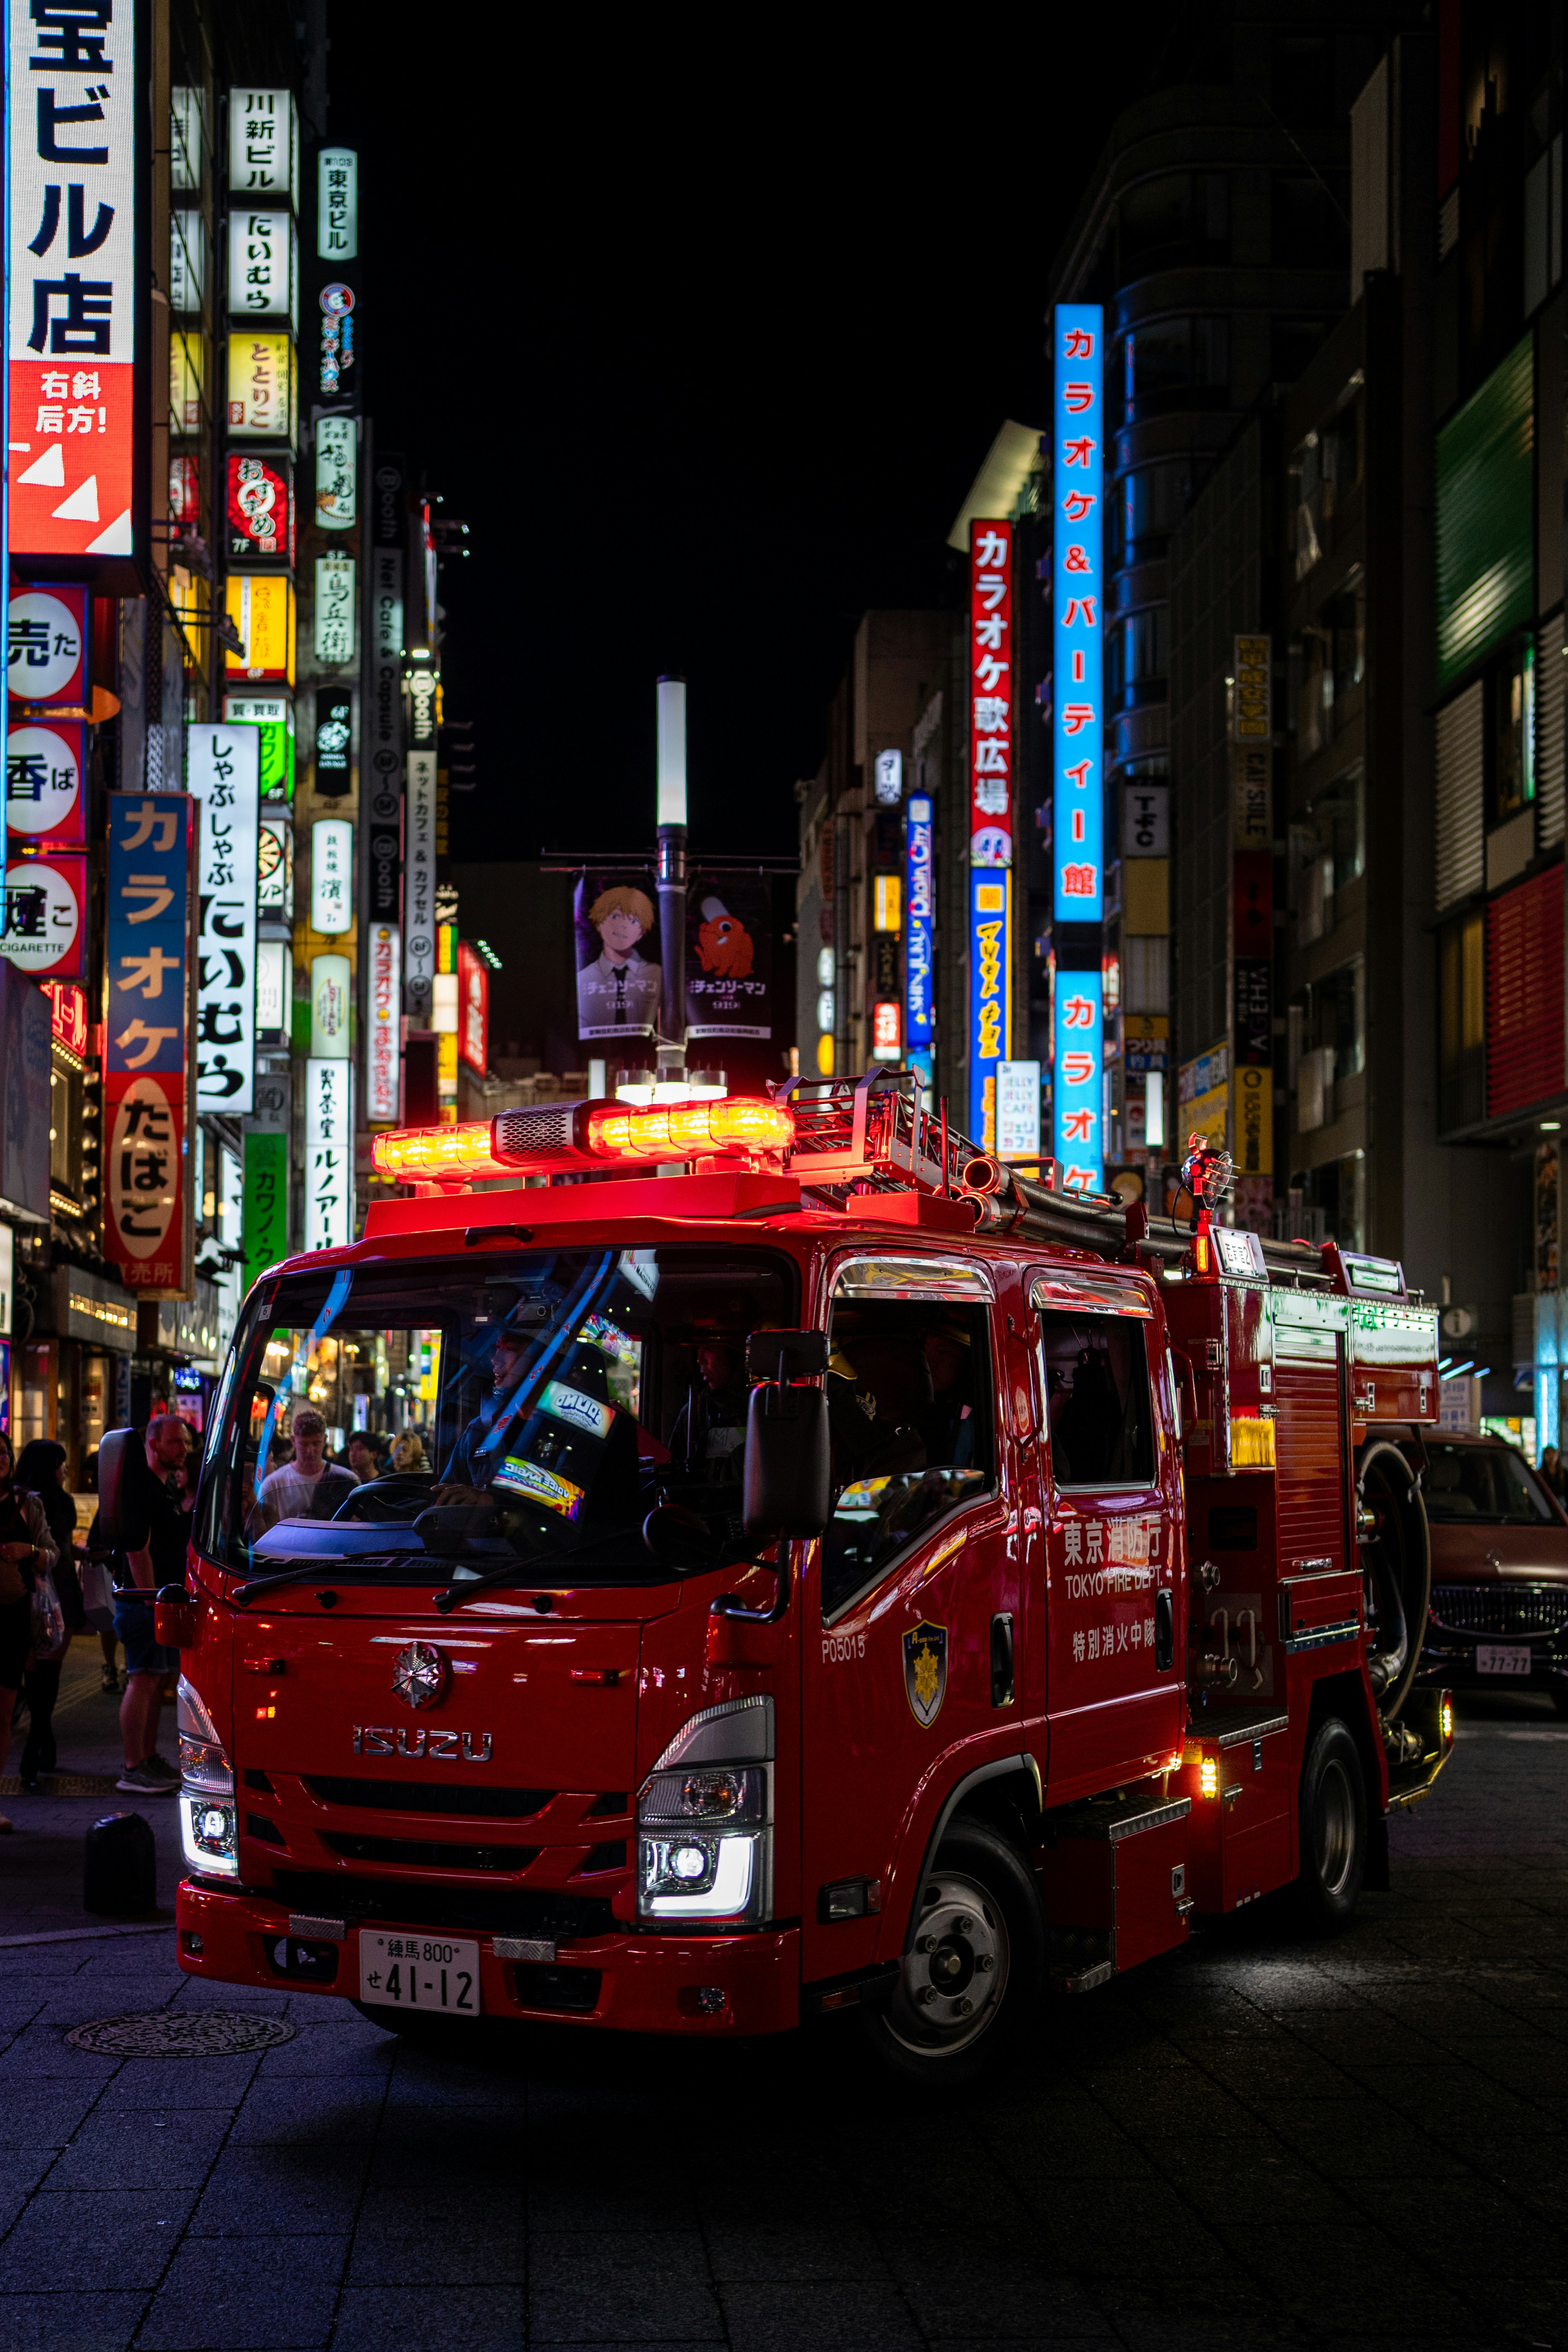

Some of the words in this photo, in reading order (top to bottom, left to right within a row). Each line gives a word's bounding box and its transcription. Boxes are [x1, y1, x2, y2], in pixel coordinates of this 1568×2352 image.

[244, 94, 275, 187] 川新ビル
[328, 169, 349, 250] 東京ビル
[247, 215, 273, 309] にいむら
[36, 405, 107, 434] 后方!
[40, 371, 101, 400] 右斜
[232, 538, 255, 553] 7F
[1061, 328, 1097, 899] カラオケ&パーティー館
[974, 530, 1009, 816] カラオケ歌広場
[208, 734, 235, 886] しゃぶしゃぶ
[114, 801, 181, 1070] カラオケ
[197, 895, 245, 1098] にいむら
[321, 1068, 337, 1138] 喫茶室
[1062, 995, 1096, 1191] カラオケ
[120, 1099, 170, 1236] たばこ
[1064, 1516, 1162, 1567] 東京消防庁
[1065, 1574, 1104, 1600] TOKYO
[1107, 1570, 1132, 1595] FIRE
[1134, 1567, 1163, 1591] DEPT.
[1072, 1616, 1157, 1663] 特別消火中隊
[352, 1725, 493, 1762] ISUZU
[367, 1970, 382, 1989] せ
[385, 1963, 473, 2010] 41-12
[387, 1937, 420, 1962] 練馬
[423, 1943, 452, 1963] 800
